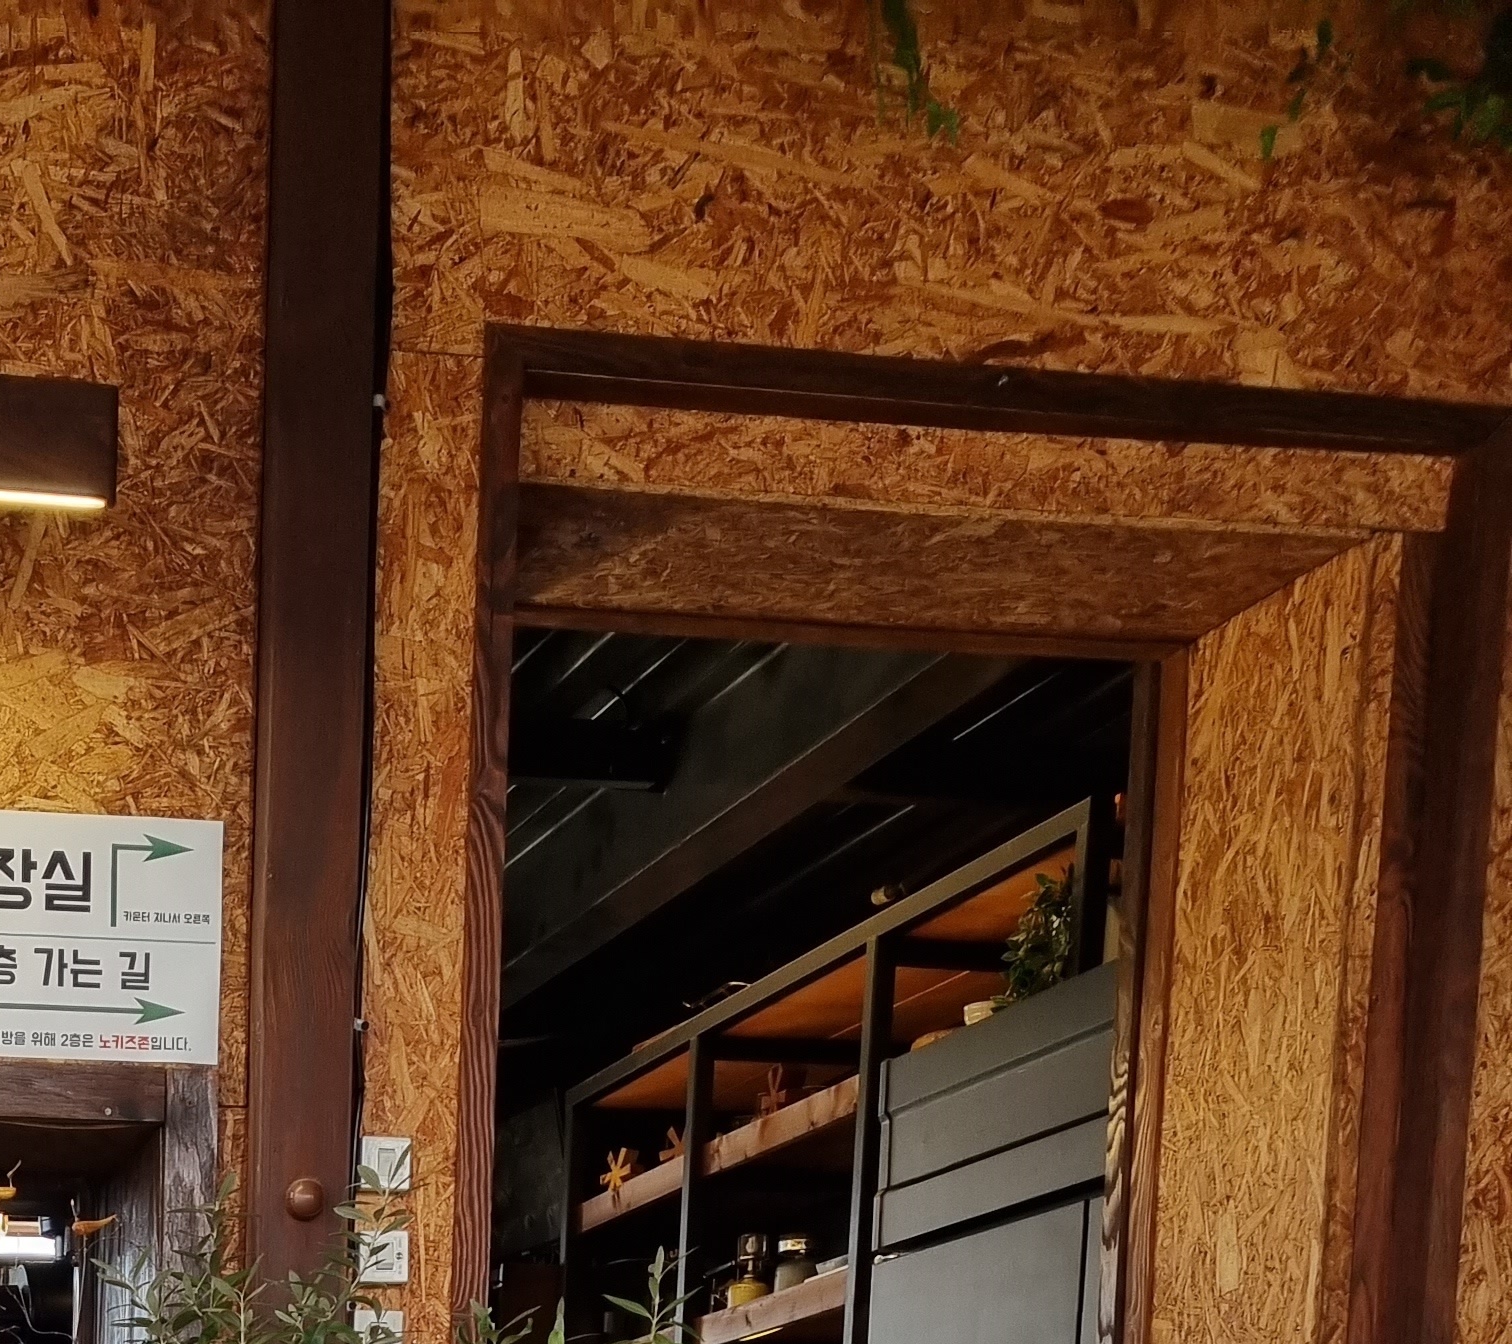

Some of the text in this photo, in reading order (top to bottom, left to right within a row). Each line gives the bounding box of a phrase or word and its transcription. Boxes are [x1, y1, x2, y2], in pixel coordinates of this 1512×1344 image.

[153, 911, 181, 924] 지나서
[183, 913, 210, 925] 오른쪽
[33, 947, 103, 989] 가는
[118, 951, 151, 991] 길
[30, 1031, 56, 1047] 위해
[60, 1033, 94, 1048] 2층은
[98, 1034, 192, 1052] 노키즈존입니다.
